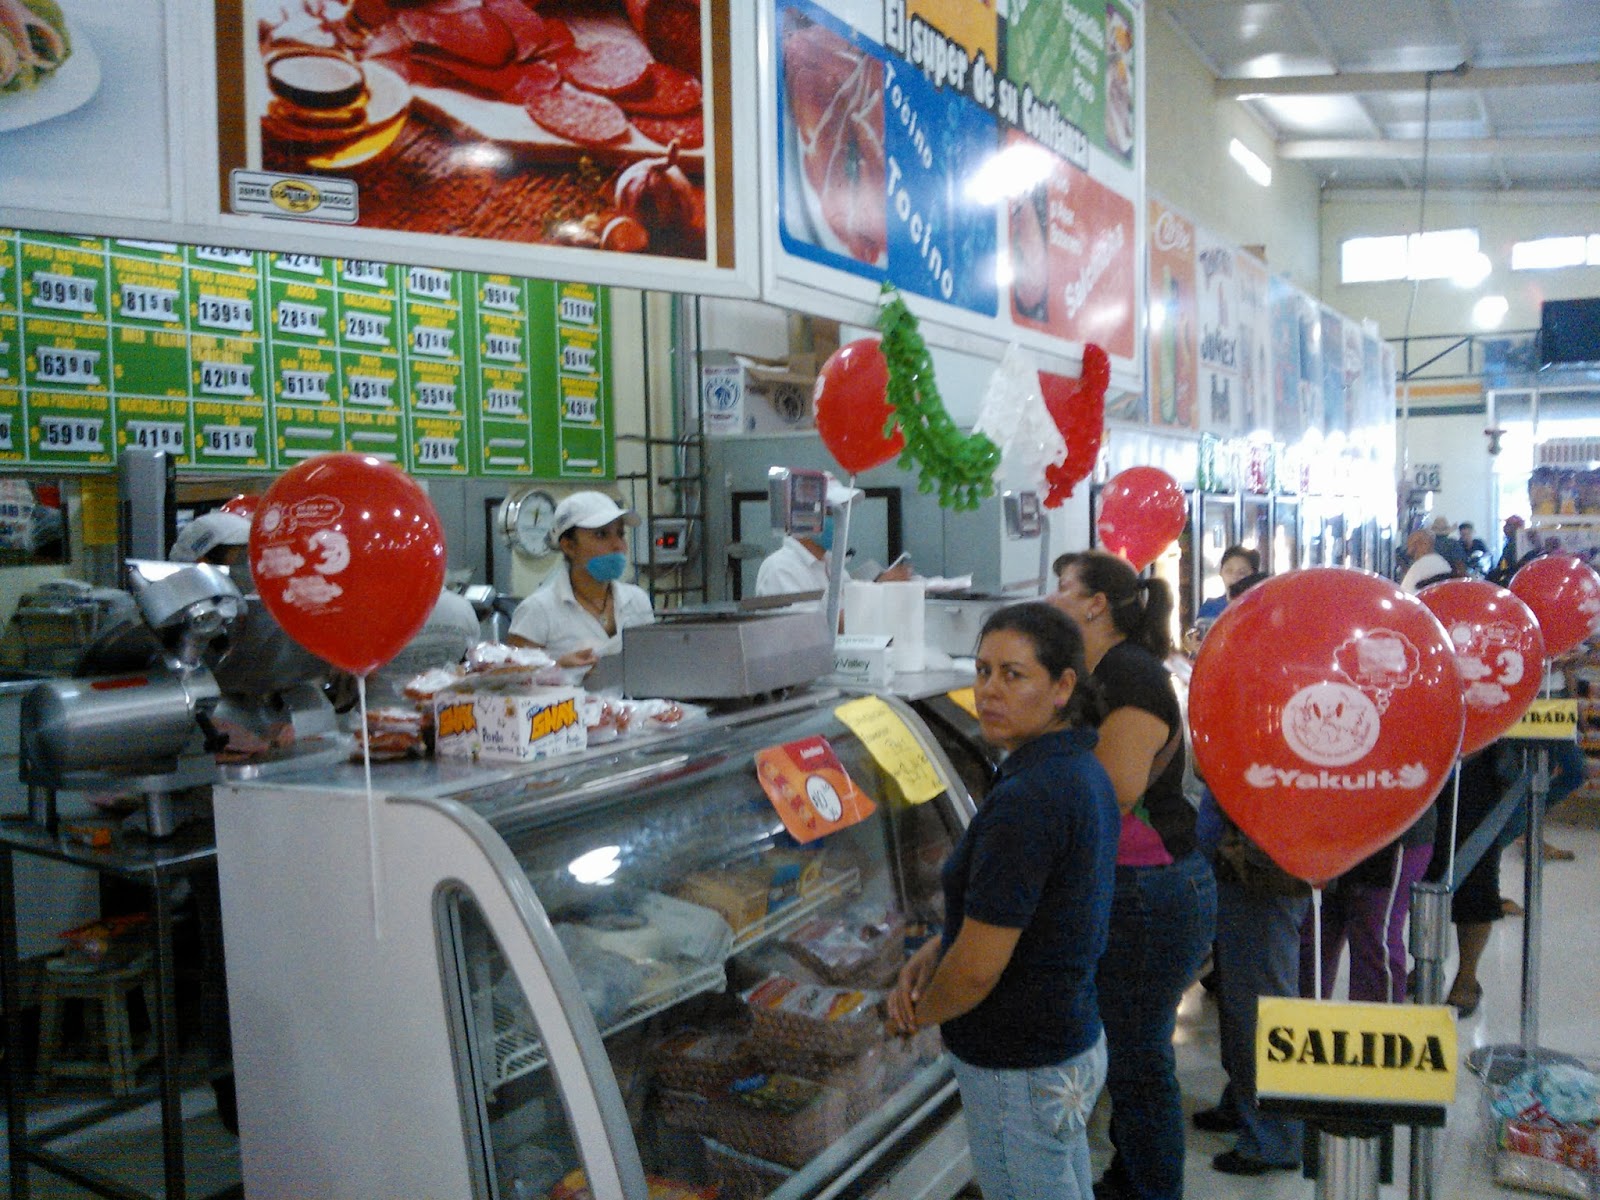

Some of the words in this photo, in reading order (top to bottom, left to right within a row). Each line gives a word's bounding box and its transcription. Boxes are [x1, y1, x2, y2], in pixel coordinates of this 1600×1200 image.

[910, 17, 969, 91] super
[972, 51, 996, 110] de
[998, 77, 1019, 125] su
[886, 155, 954, 300] Tocino
[1521, 710, 1577, 724] TRADA
[1276, 768, 1398, 791] Yakult
[1266, 1025, 1450, 1073] SALIDA
